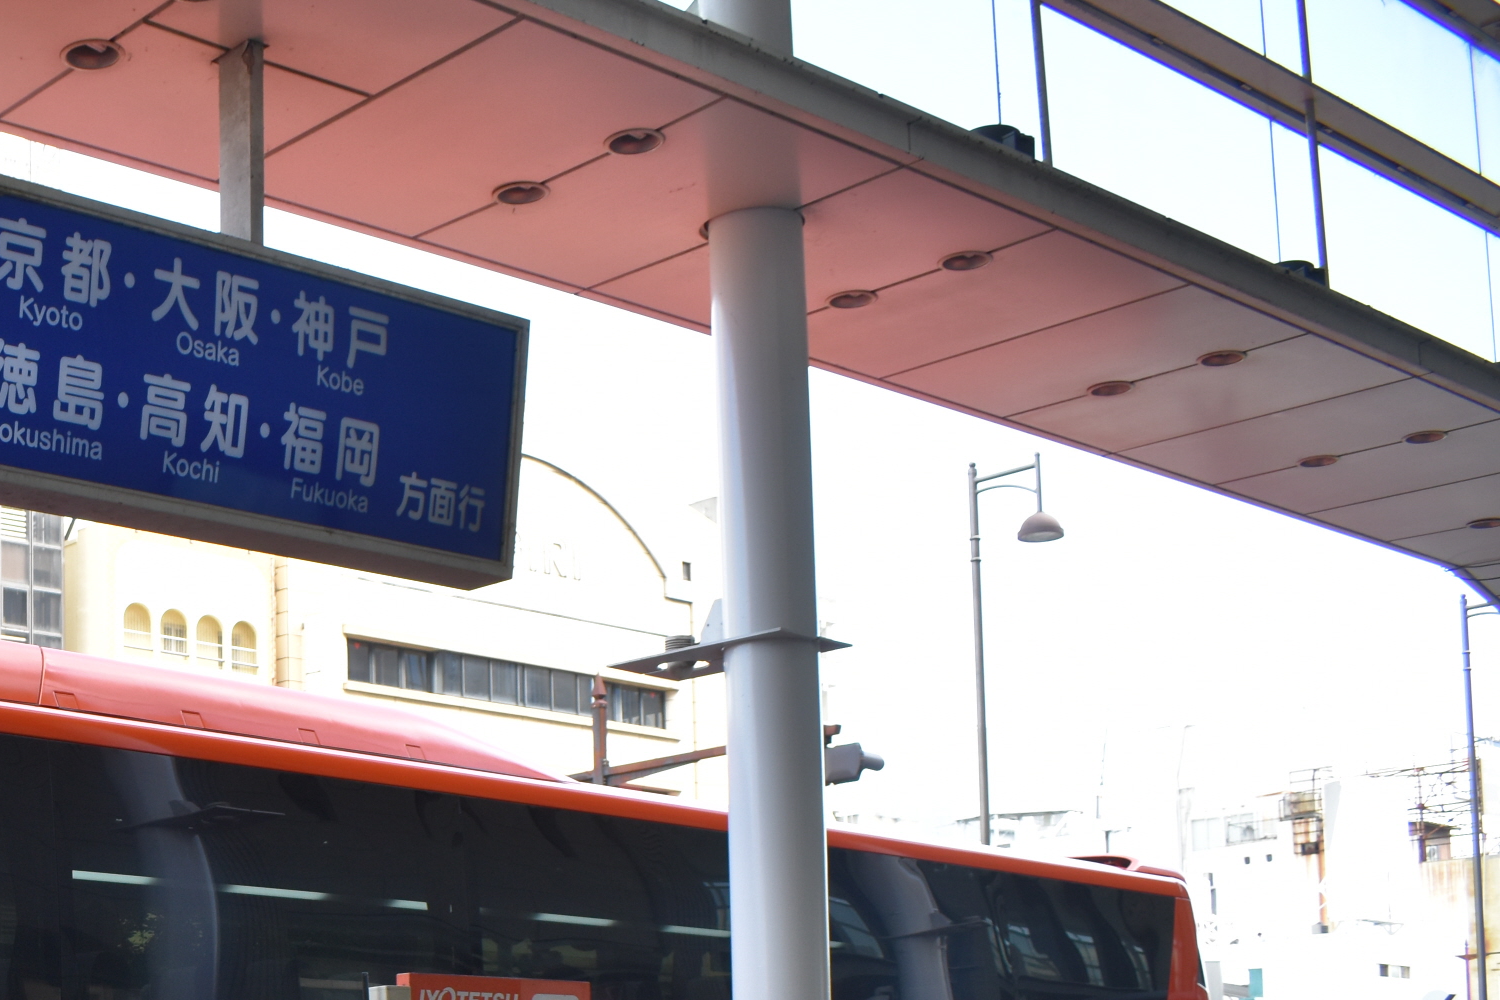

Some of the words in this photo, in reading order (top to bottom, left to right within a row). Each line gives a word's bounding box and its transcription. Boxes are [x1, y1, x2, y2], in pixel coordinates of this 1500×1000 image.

[18, 294, 84, 333] Kyoto
[176, 332, 241, 367] Osaka
[316, 363, 365, 397] Kobe
[162, 452, 220, 485] Kochi
[290, 478, 369, 513] Fukuoka
[396, 471, 486, 533] 方面行
